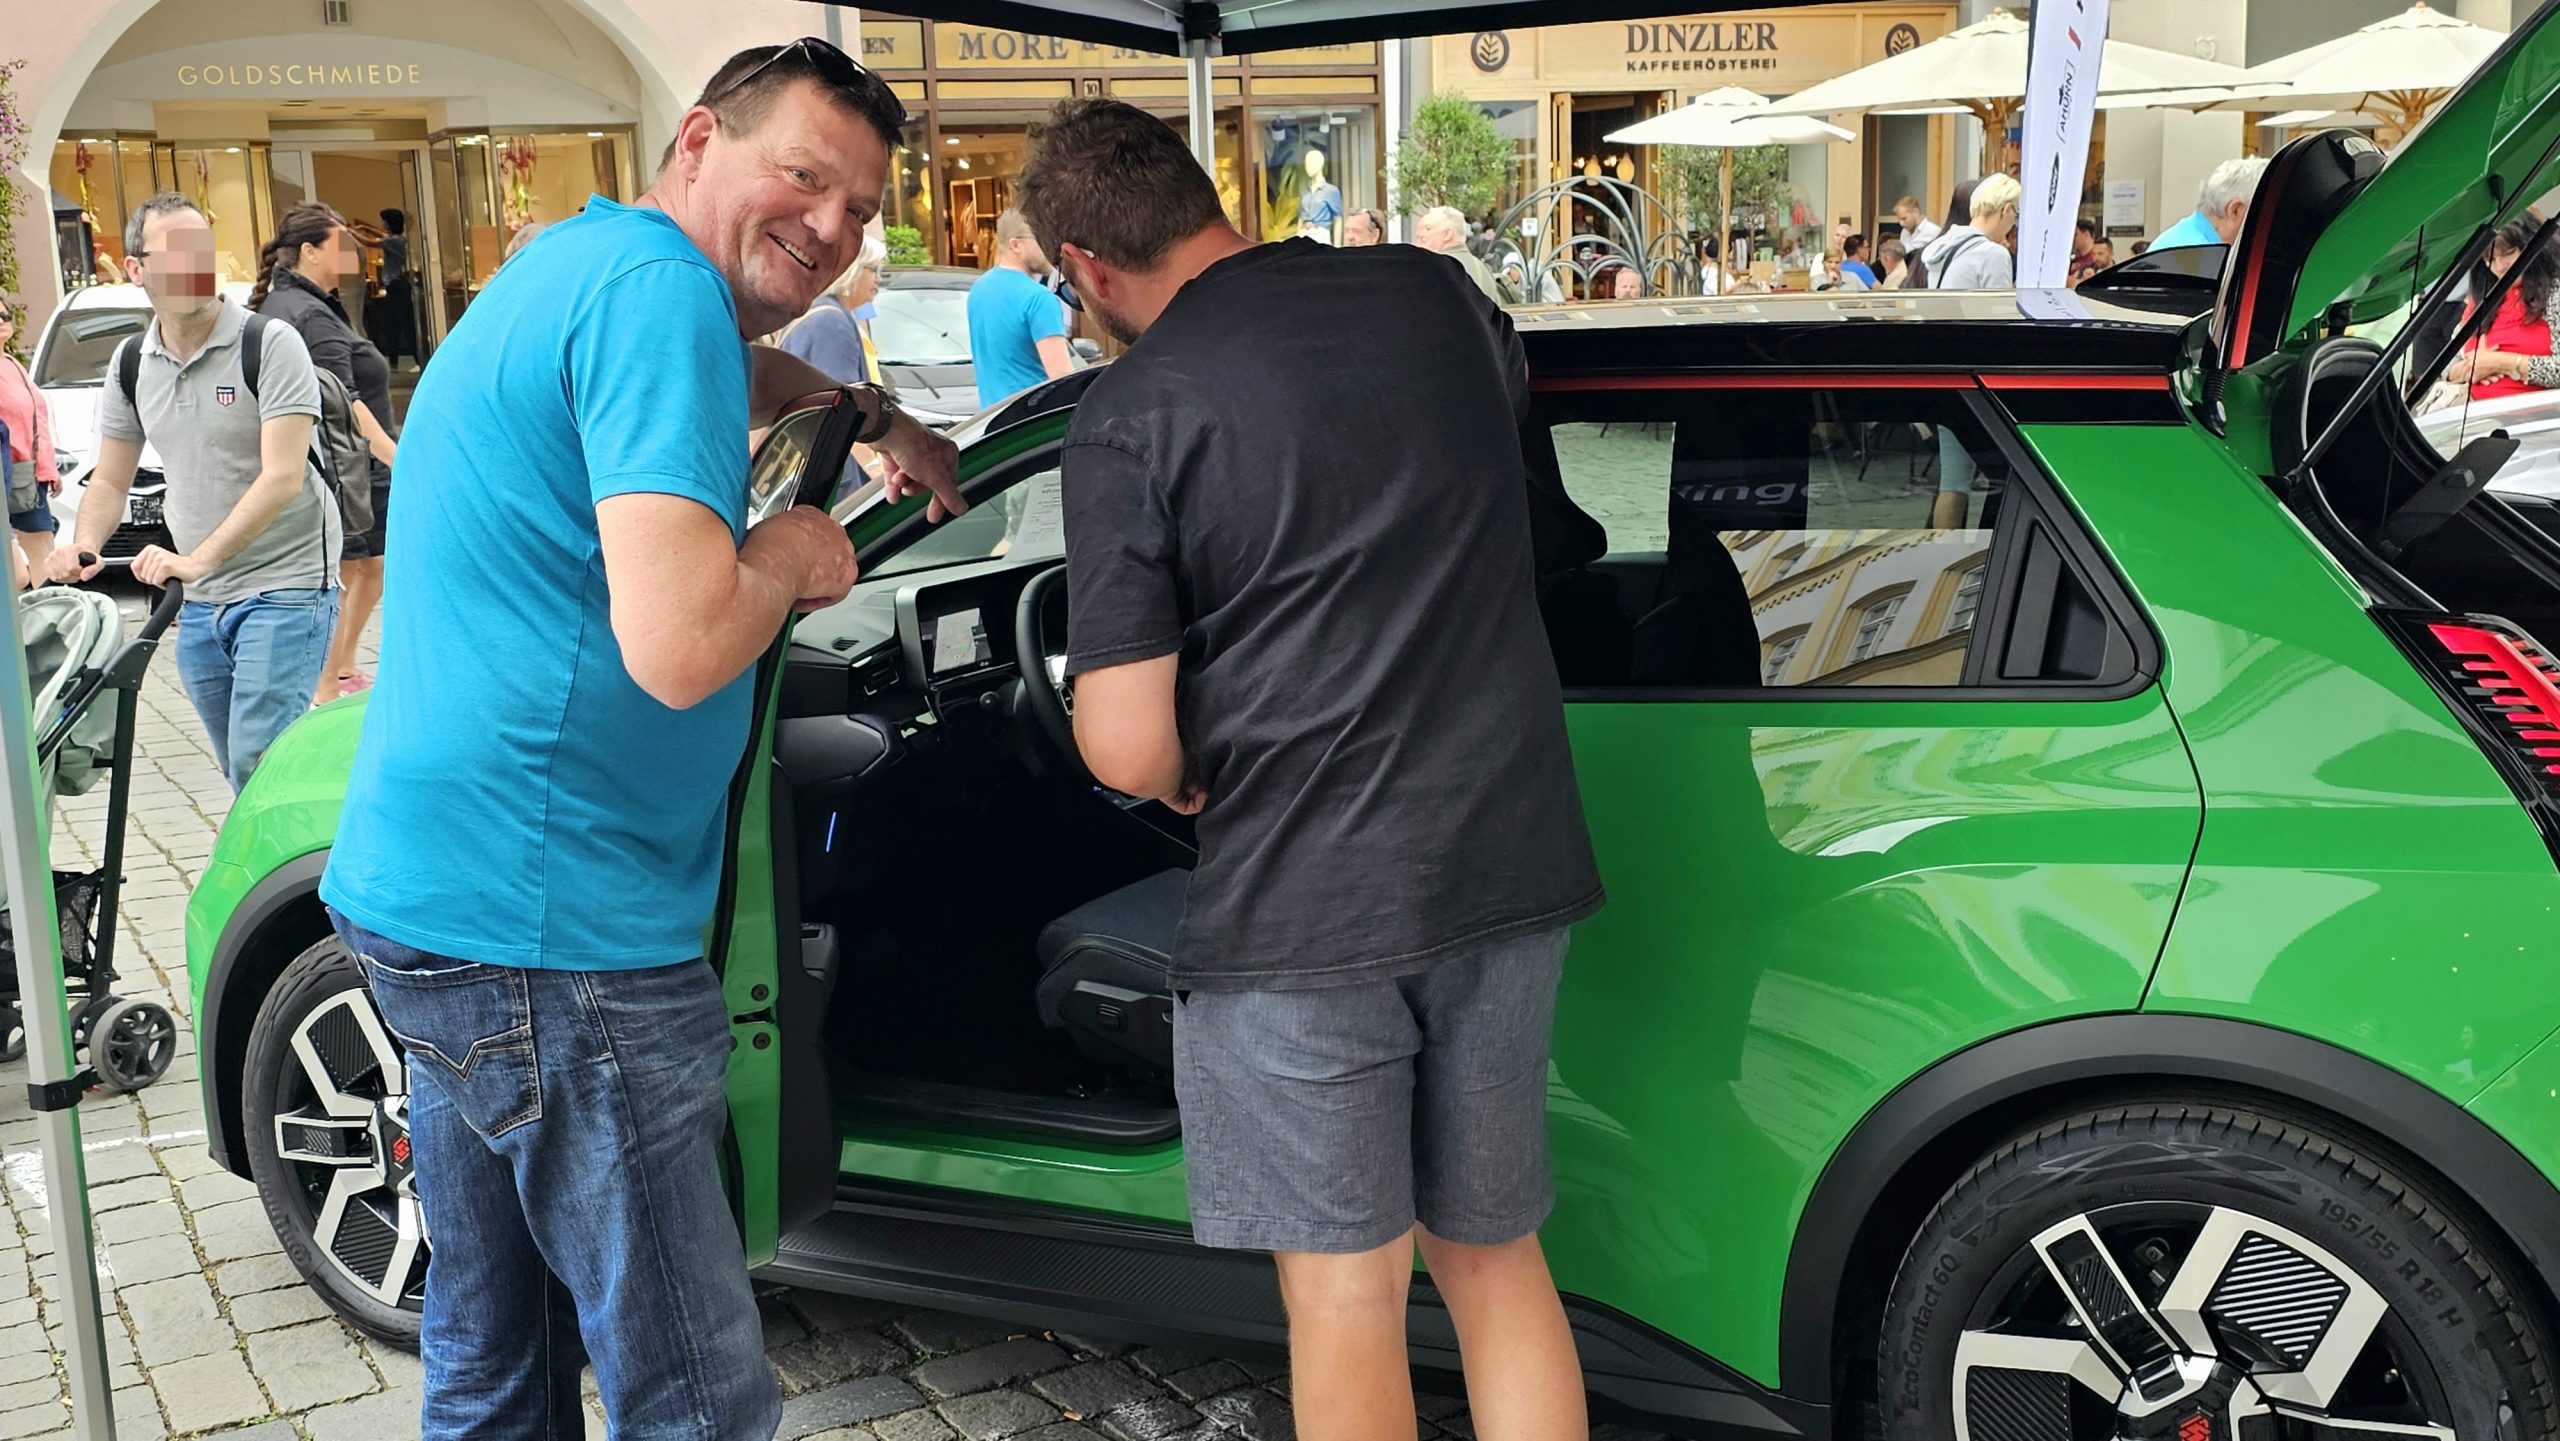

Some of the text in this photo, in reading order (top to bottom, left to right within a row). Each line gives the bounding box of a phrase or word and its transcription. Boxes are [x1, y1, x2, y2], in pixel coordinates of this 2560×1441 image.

[959, 32, 1069, 60] MORE
[1625, 22, 1778, 53] DINZLER
[177, 64, 421, 86] GOLDSCHMIEDE
[1627, 57, 1776, 72] KAFFEERÖSTEREI
[1086, 83, 1098, 95] 10
[2318, 1198, 2399, 1261] 195/55
[2397, 1258, 2421, 1282] R
[2415, 1277, 2444, 1306] 18
[2436, 1307, 2464, 1329] H
[1904, 1253, 1963, 1412] EcoContact 6Q
